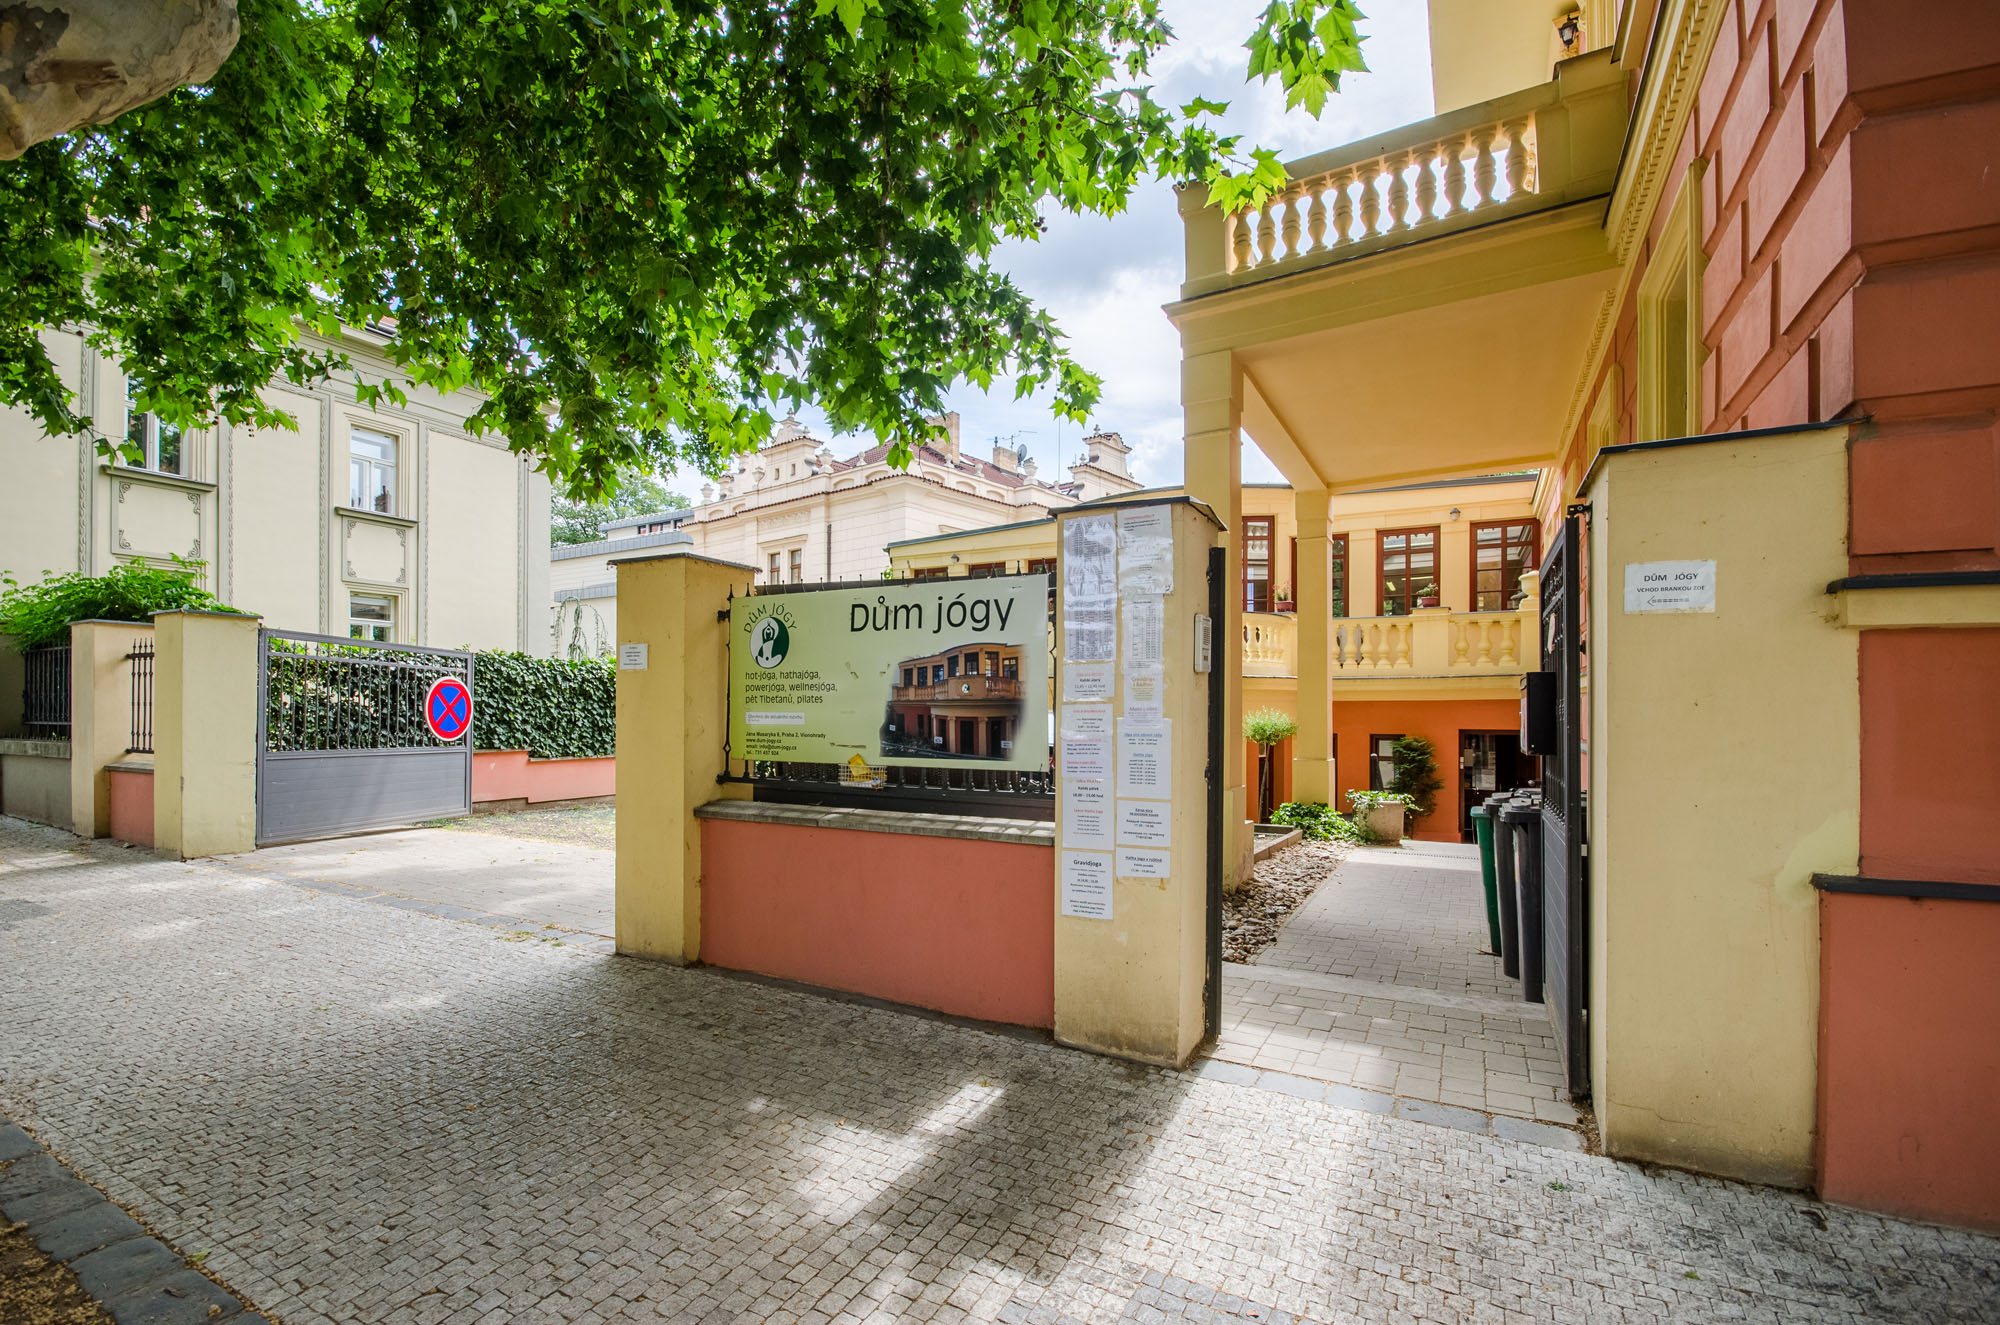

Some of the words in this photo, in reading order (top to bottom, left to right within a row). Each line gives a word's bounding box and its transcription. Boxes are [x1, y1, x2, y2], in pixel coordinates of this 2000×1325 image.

[1644, 573, 1667, 582] DŮM
[1674, 572, 1698, 581] JÓGY
[768, 602, 798, 630] JÓGY
[850, 595, 923, 632] Dům
[932, 593, 1015, 634] jógy
[745, 671, 778, 681] hot-jóga,
[780, 669, 821, 680] hathajóga,
[745, 683, 787, 692] powerjóga,
[789, 681, 838, 692] wellnesjóga,
[760, 693, 795, 704] Tibetanů,
[797, 694, 824, 704] pilates
[1073, 859, 1102, 868] Gravidjoga
